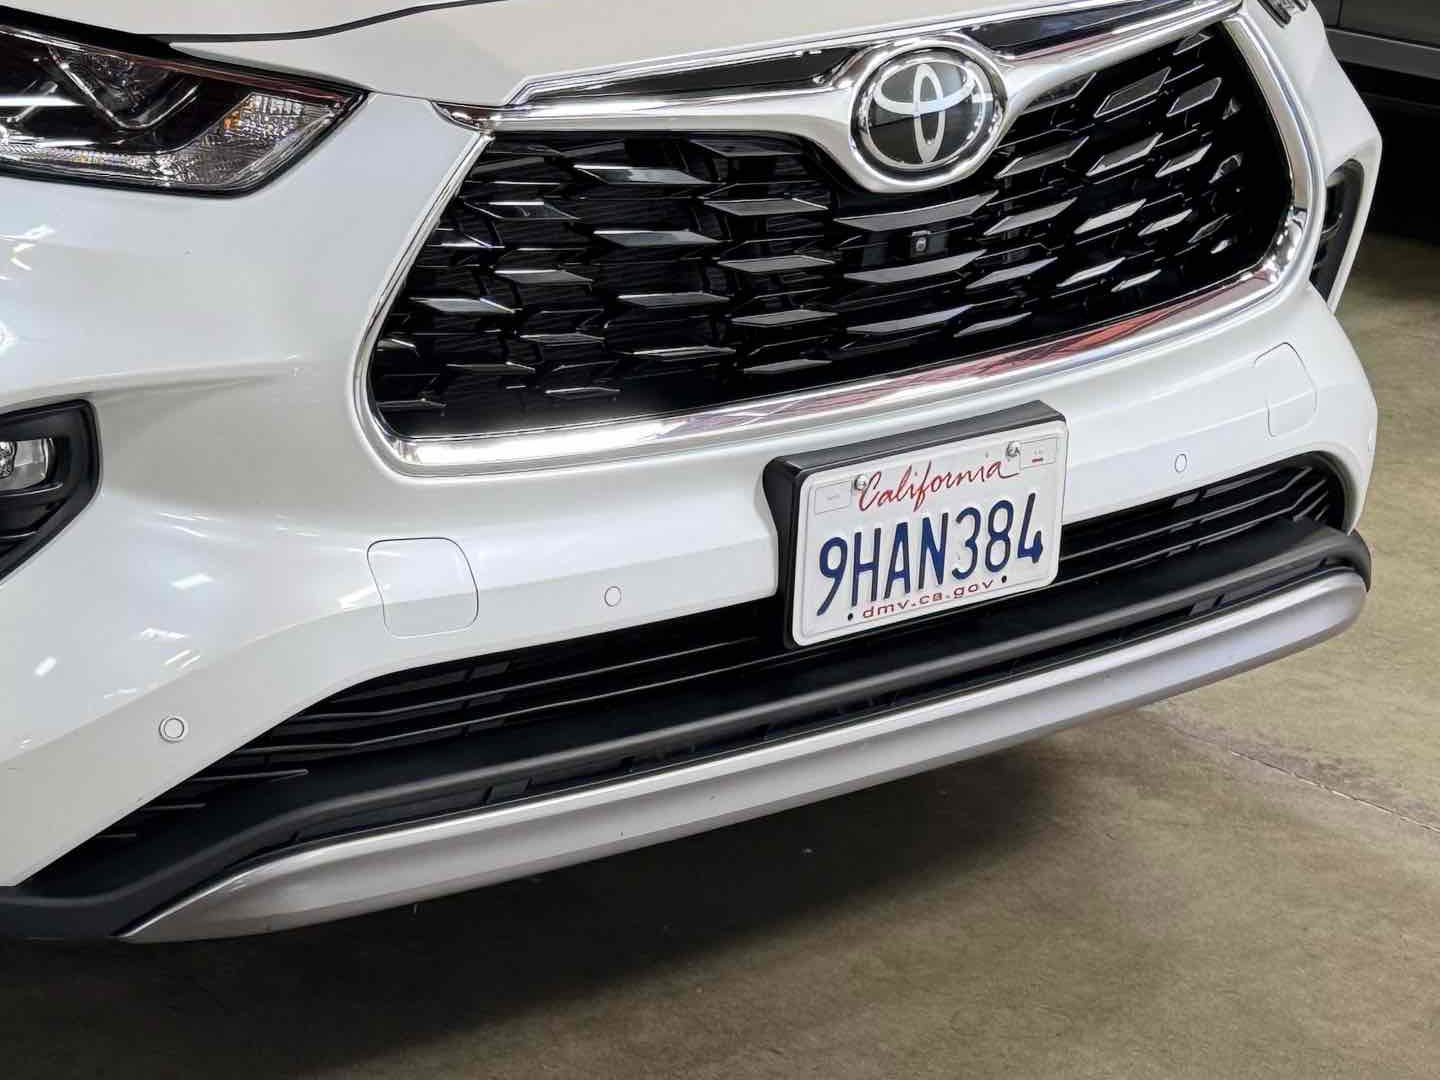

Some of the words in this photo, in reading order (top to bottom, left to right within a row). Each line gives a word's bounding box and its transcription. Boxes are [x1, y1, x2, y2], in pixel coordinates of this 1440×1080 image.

[858, 459, 1020, 512] California
[816, 492, 1044, 617] 9HAN384
[862, 578, 995, 619] dmv.ca.gov
